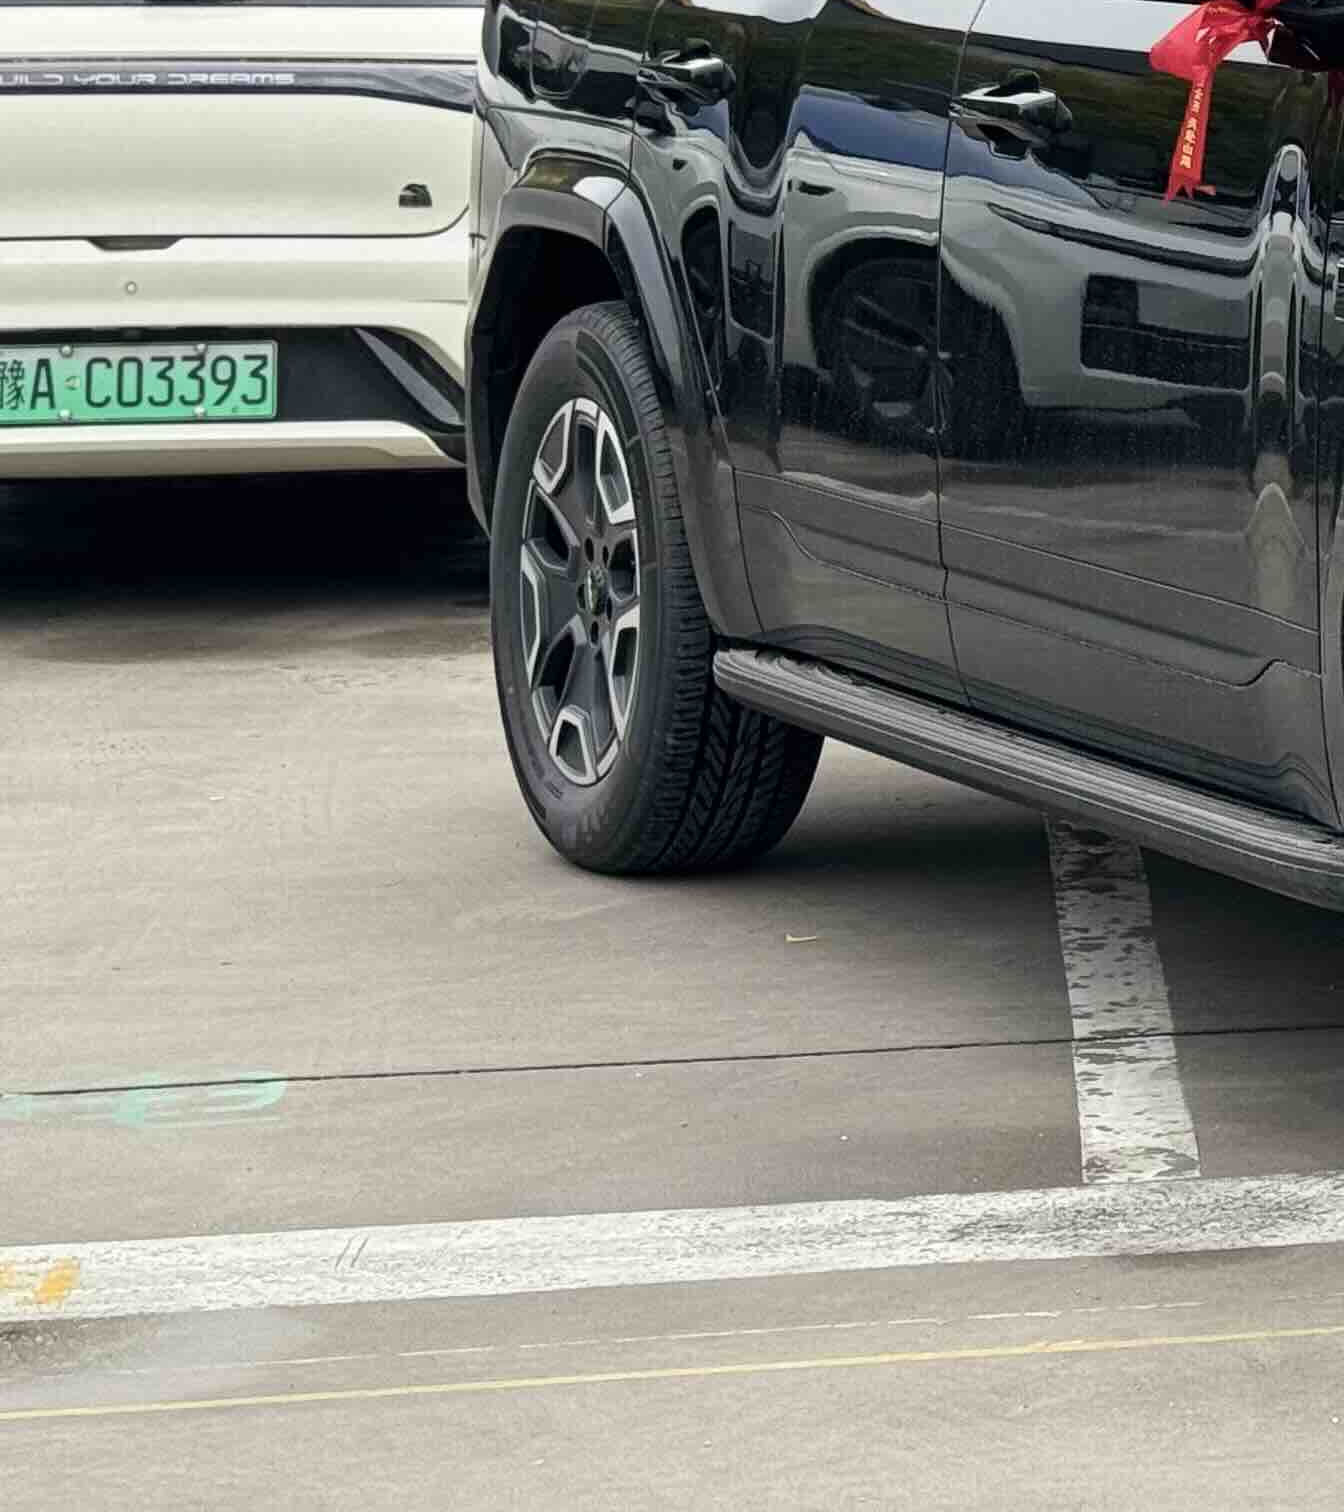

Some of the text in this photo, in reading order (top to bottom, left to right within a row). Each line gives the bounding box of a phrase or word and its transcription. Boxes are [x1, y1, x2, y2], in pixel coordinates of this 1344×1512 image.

[73, 72, 158, 86] YOUR
[167, 72, 296, 86] DREAMS
[85, 354, 269, 408] C03393
